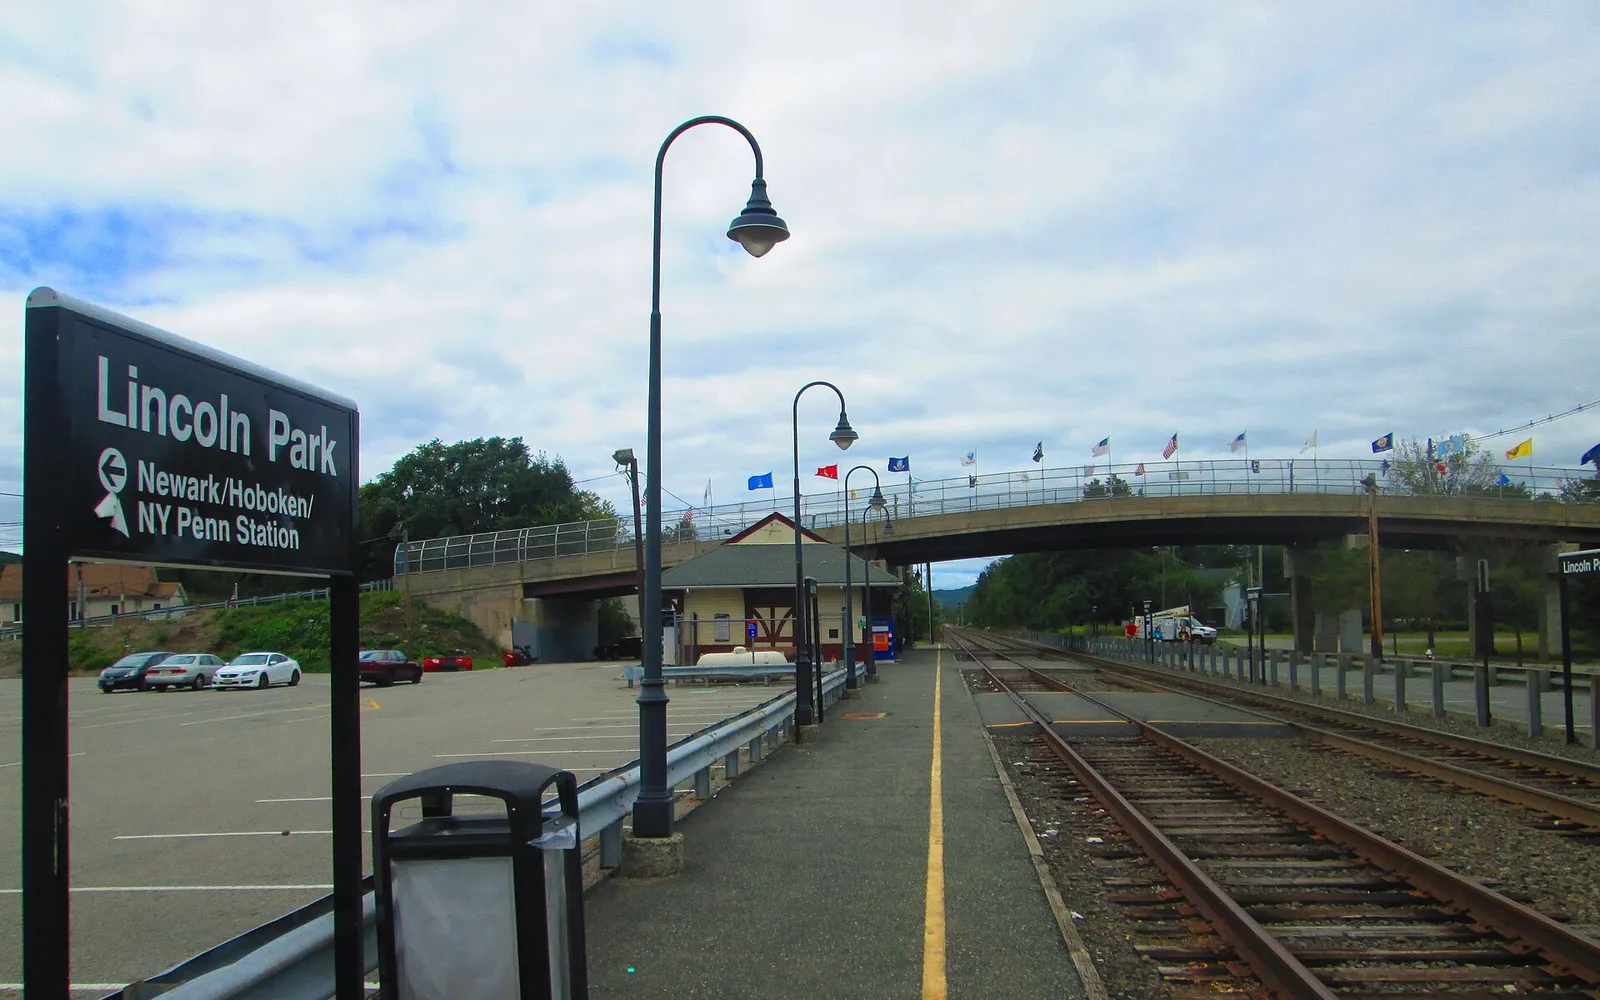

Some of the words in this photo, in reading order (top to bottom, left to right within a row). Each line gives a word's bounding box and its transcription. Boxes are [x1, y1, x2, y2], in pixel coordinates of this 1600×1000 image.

[98, 355, 250, 456] Lincoln
[269, 408, 338, 477] Park
[138, 460, 314, 519] Newark/Hoboken/
[138, 501, 172, 535] NY
[177, 513, 231, 542] Penn
[236, 515, 299, 550] Station
[1563, 560, 1591, 574] Lincoln
